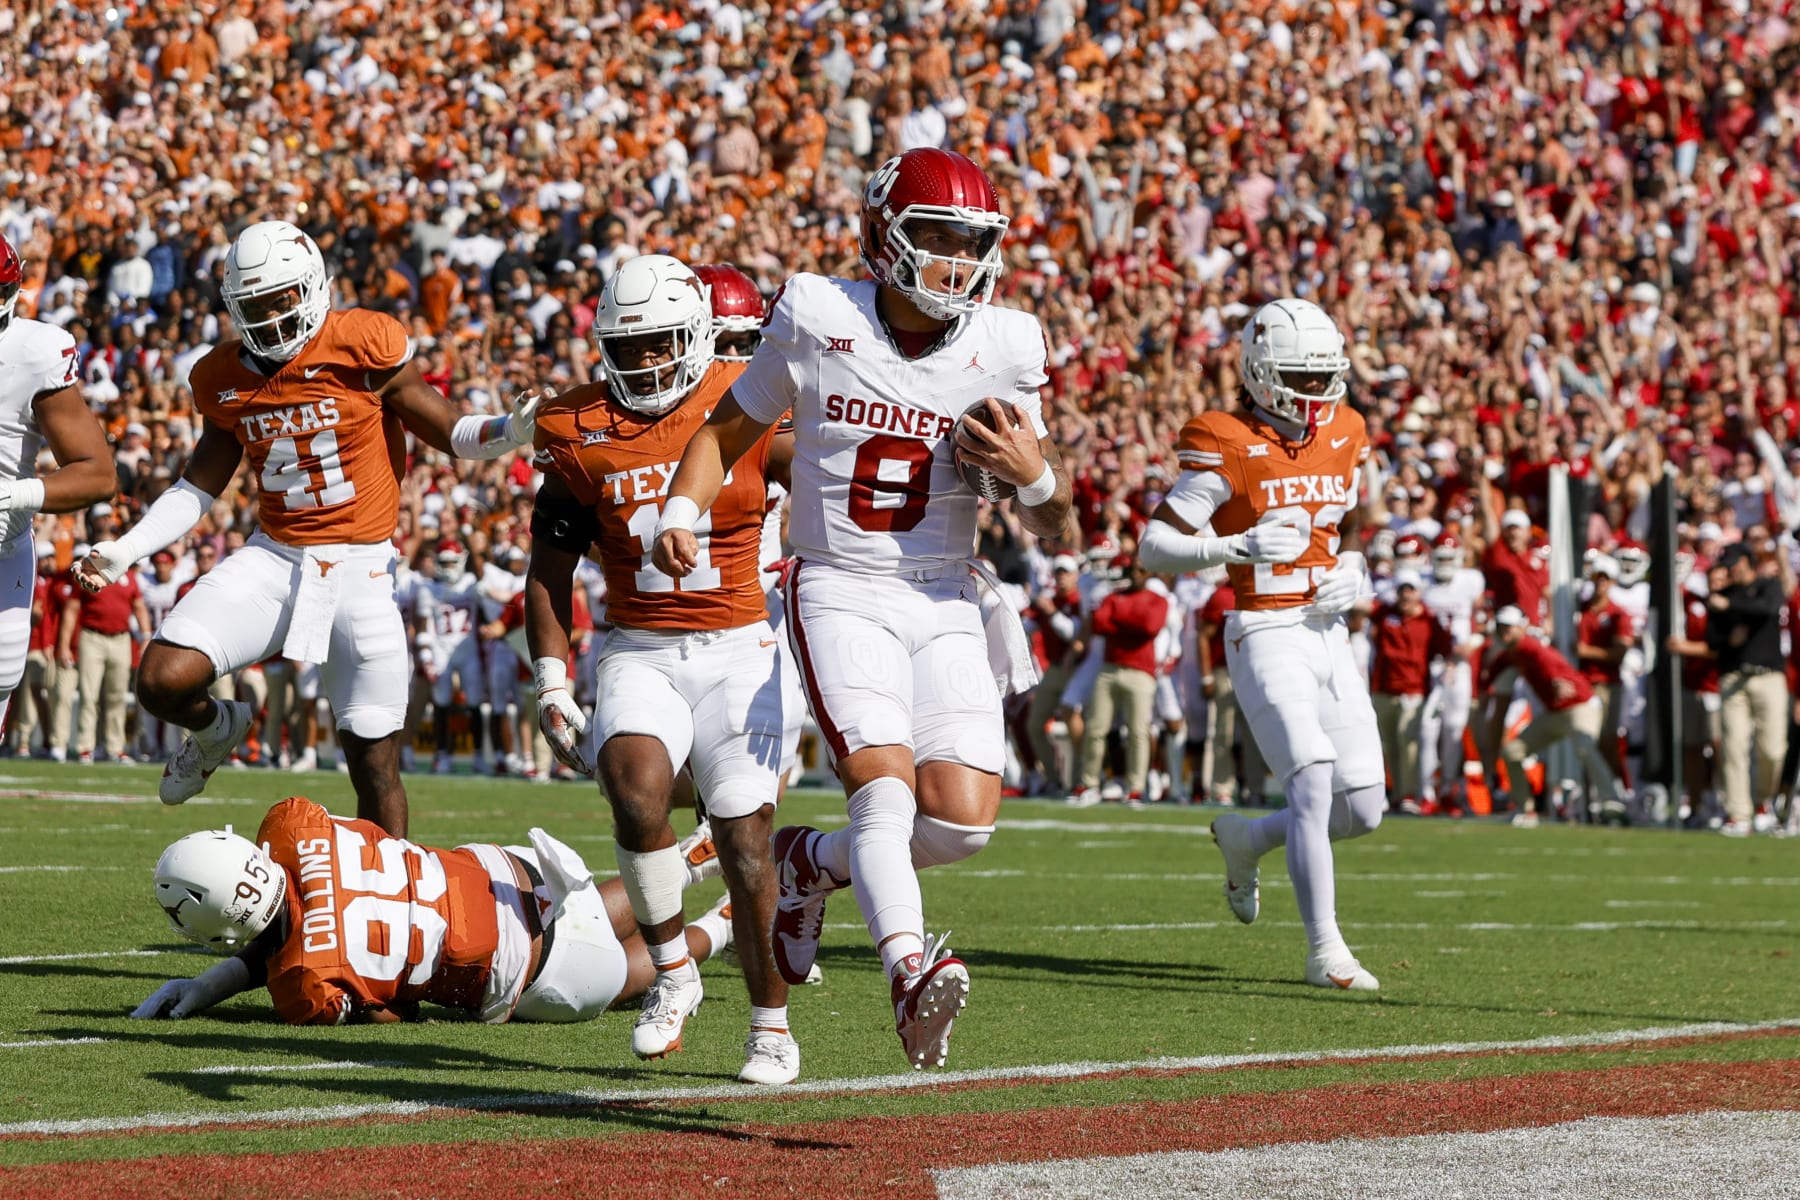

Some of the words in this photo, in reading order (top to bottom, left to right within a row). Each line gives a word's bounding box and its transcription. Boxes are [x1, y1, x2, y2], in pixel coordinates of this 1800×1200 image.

[241, 398, 340, 441] TEXAS
[261, 428, 356, 510] 41
[604, 461, 733, 505] TEX
[847, 433, 934, 532] 8
[1260, 475, 1346, 507] TEXAS
[627, 502, 722, 593] 11
[235, 857, 270, 906] 95
[296, 838, 338, 953] COLLINS
[334, 823, 448, 984] 95
